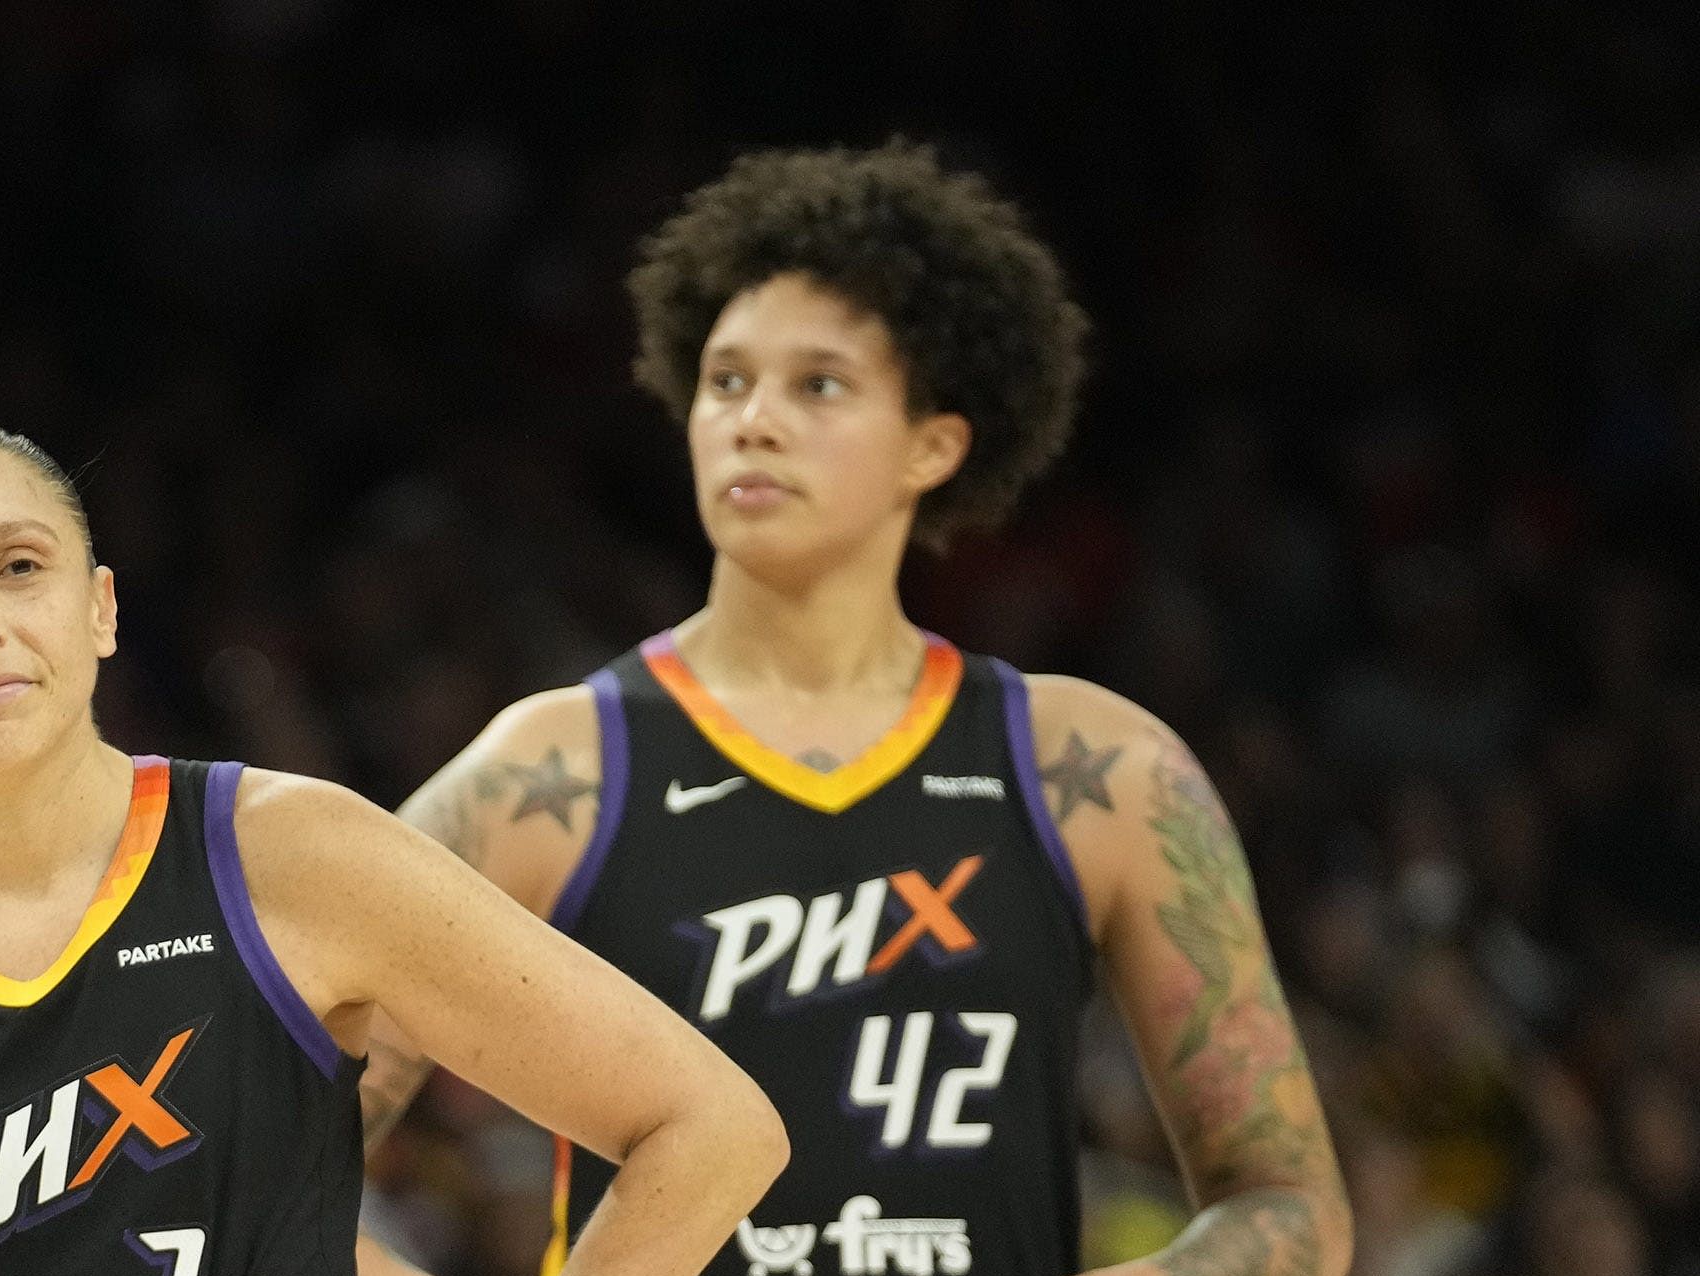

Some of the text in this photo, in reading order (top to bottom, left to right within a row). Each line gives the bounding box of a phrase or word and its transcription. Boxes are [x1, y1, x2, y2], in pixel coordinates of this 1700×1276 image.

[117, 934, 214, 968] PARTAKE
[700, 854, 984, 1022] PHX
[850, 1010, 1018, 1149] 42
